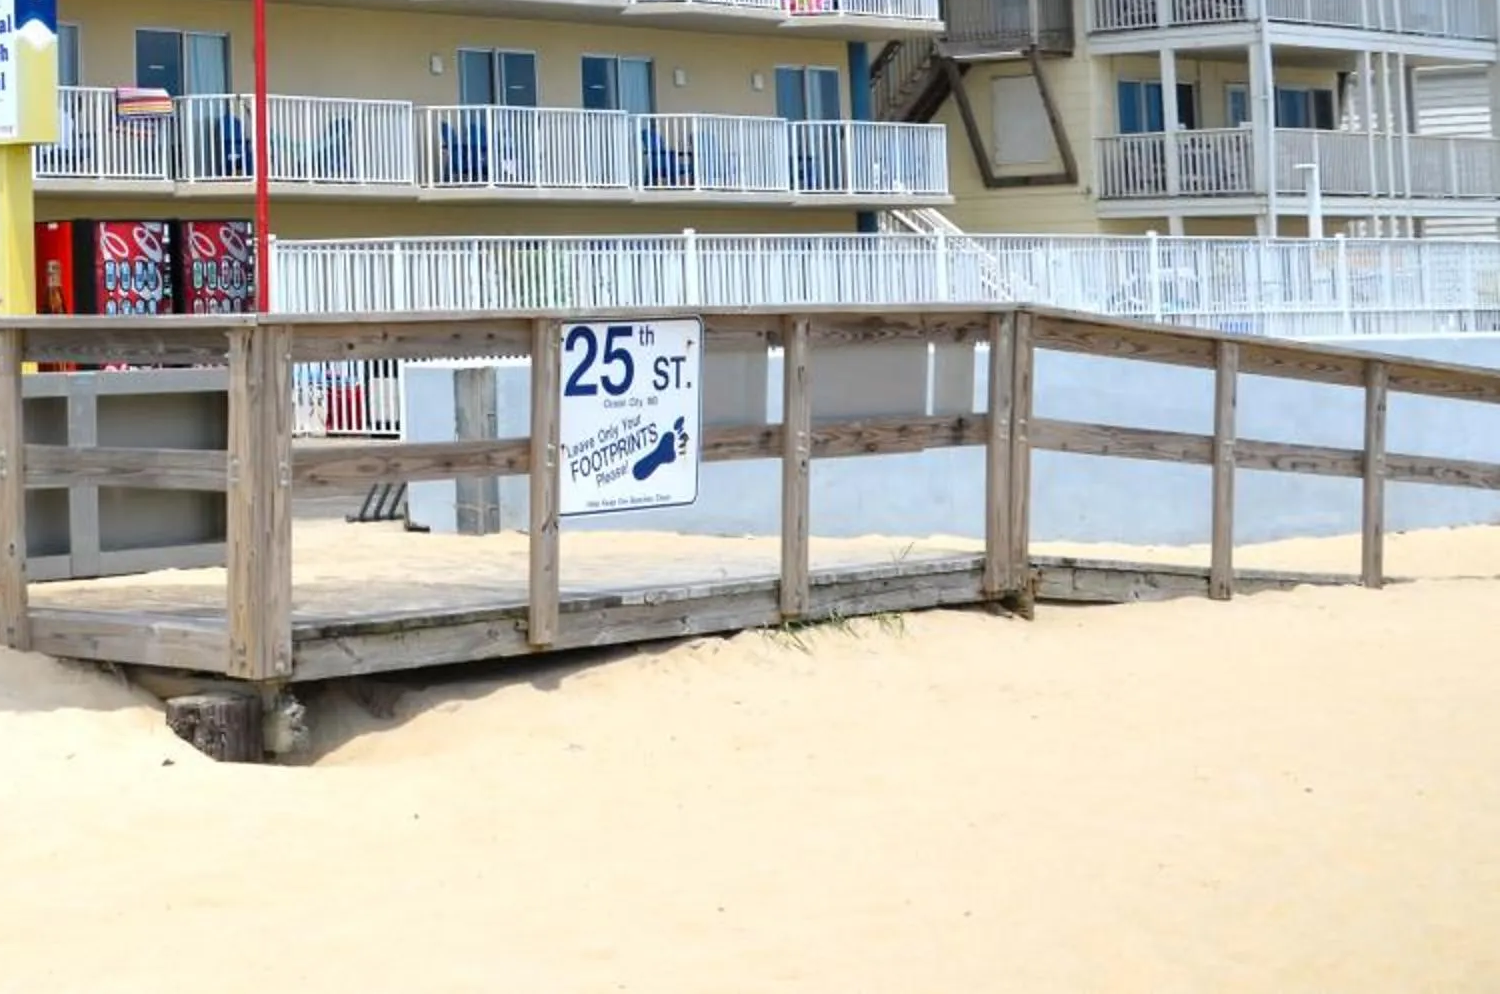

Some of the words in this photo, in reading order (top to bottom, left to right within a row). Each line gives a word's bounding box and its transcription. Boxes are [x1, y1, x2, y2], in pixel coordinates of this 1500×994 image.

[564, 325, 655, 397] 25th
[652, 356, 692, 391] ST.
[566, 437, 595, 458] Leave
[597, 424, 619, 443] Only
[622, 414, 641, 430] Your
[570, 422, 658, 483] FOOTPRINTS
